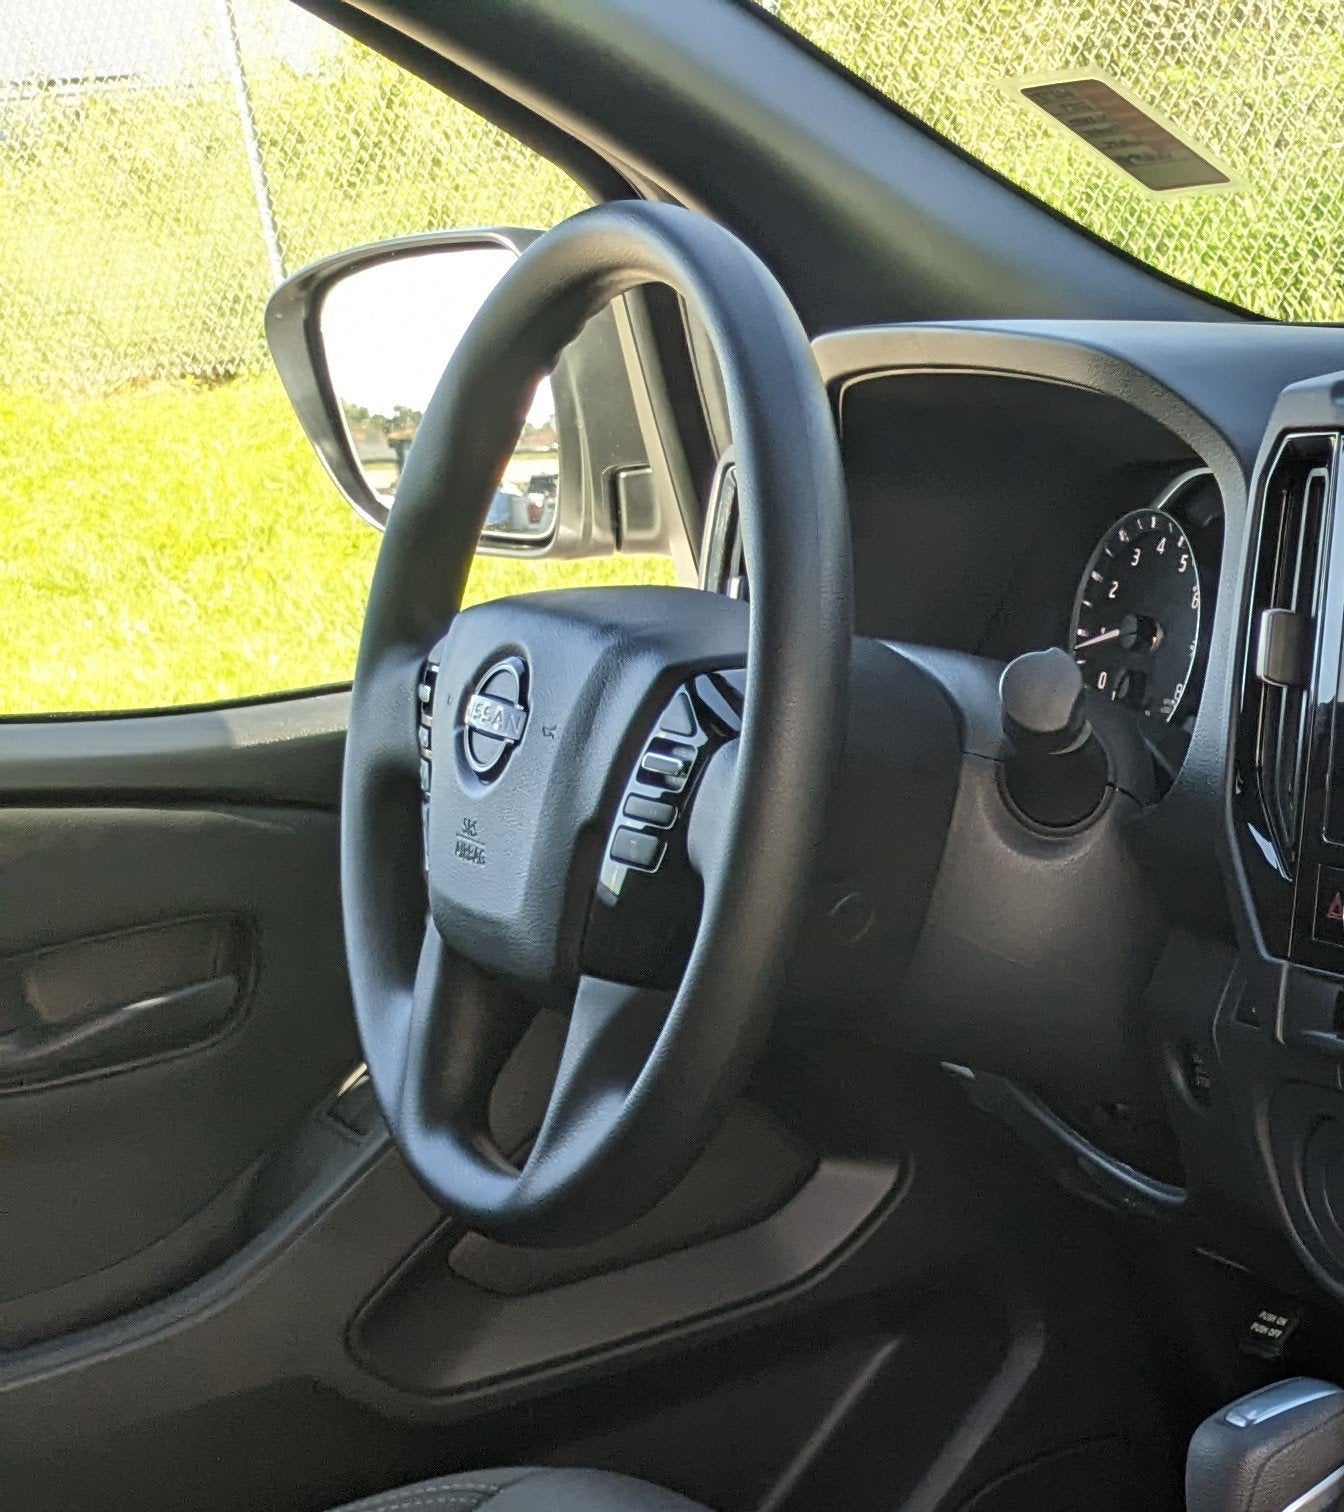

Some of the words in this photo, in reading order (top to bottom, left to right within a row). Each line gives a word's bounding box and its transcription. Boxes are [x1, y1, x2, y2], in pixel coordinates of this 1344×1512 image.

[1156, 537, 1167, 555] 4
[1130, 548, 1141, 566] 3
[1178, 554, 1189, 572] 5
[1107, 580, 1120, 599] 2
[1097, 671, 1107, 690] 0
